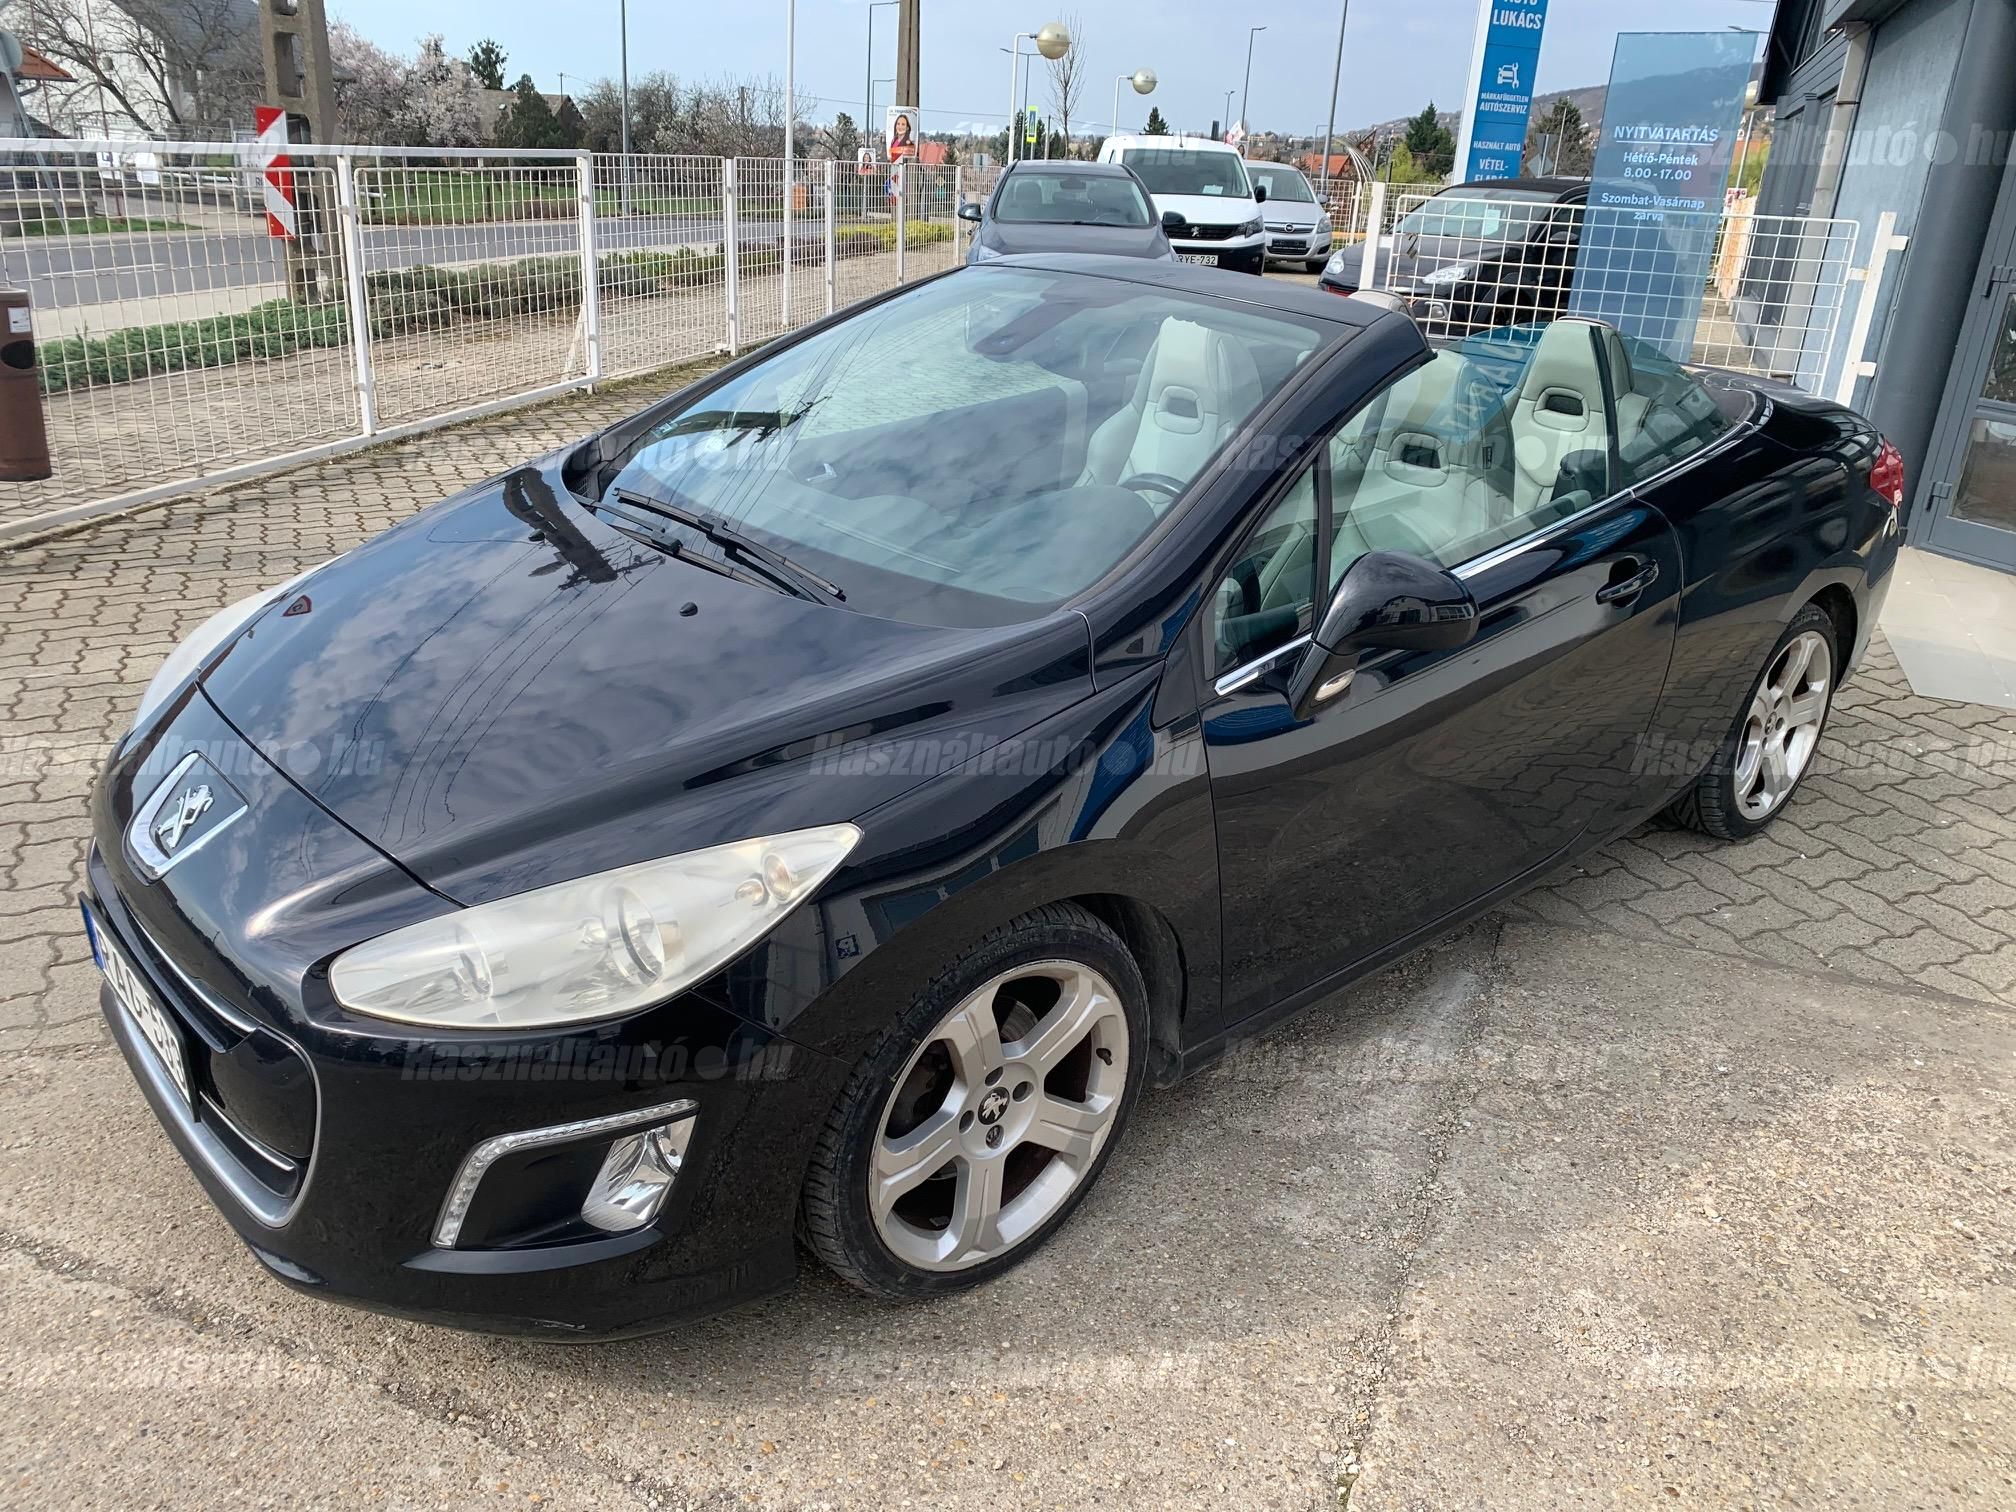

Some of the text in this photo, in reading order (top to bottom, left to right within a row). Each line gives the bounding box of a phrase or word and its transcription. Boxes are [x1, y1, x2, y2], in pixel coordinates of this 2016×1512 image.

[1493, 9, 1542, 29] LUKÁCS
[1480, 101, 1527, 114] AUTÓSZERVIZ
[1614, 124, 1719, 142] NYITVATARTÁS
[1473, 140, 1521, 151] HASZNÁLT AUTÓ
[1623, 151, 1699, 166] Hétfő-Péntek
[1601, 192, 1705, 210] Szombat-Vasárnap
